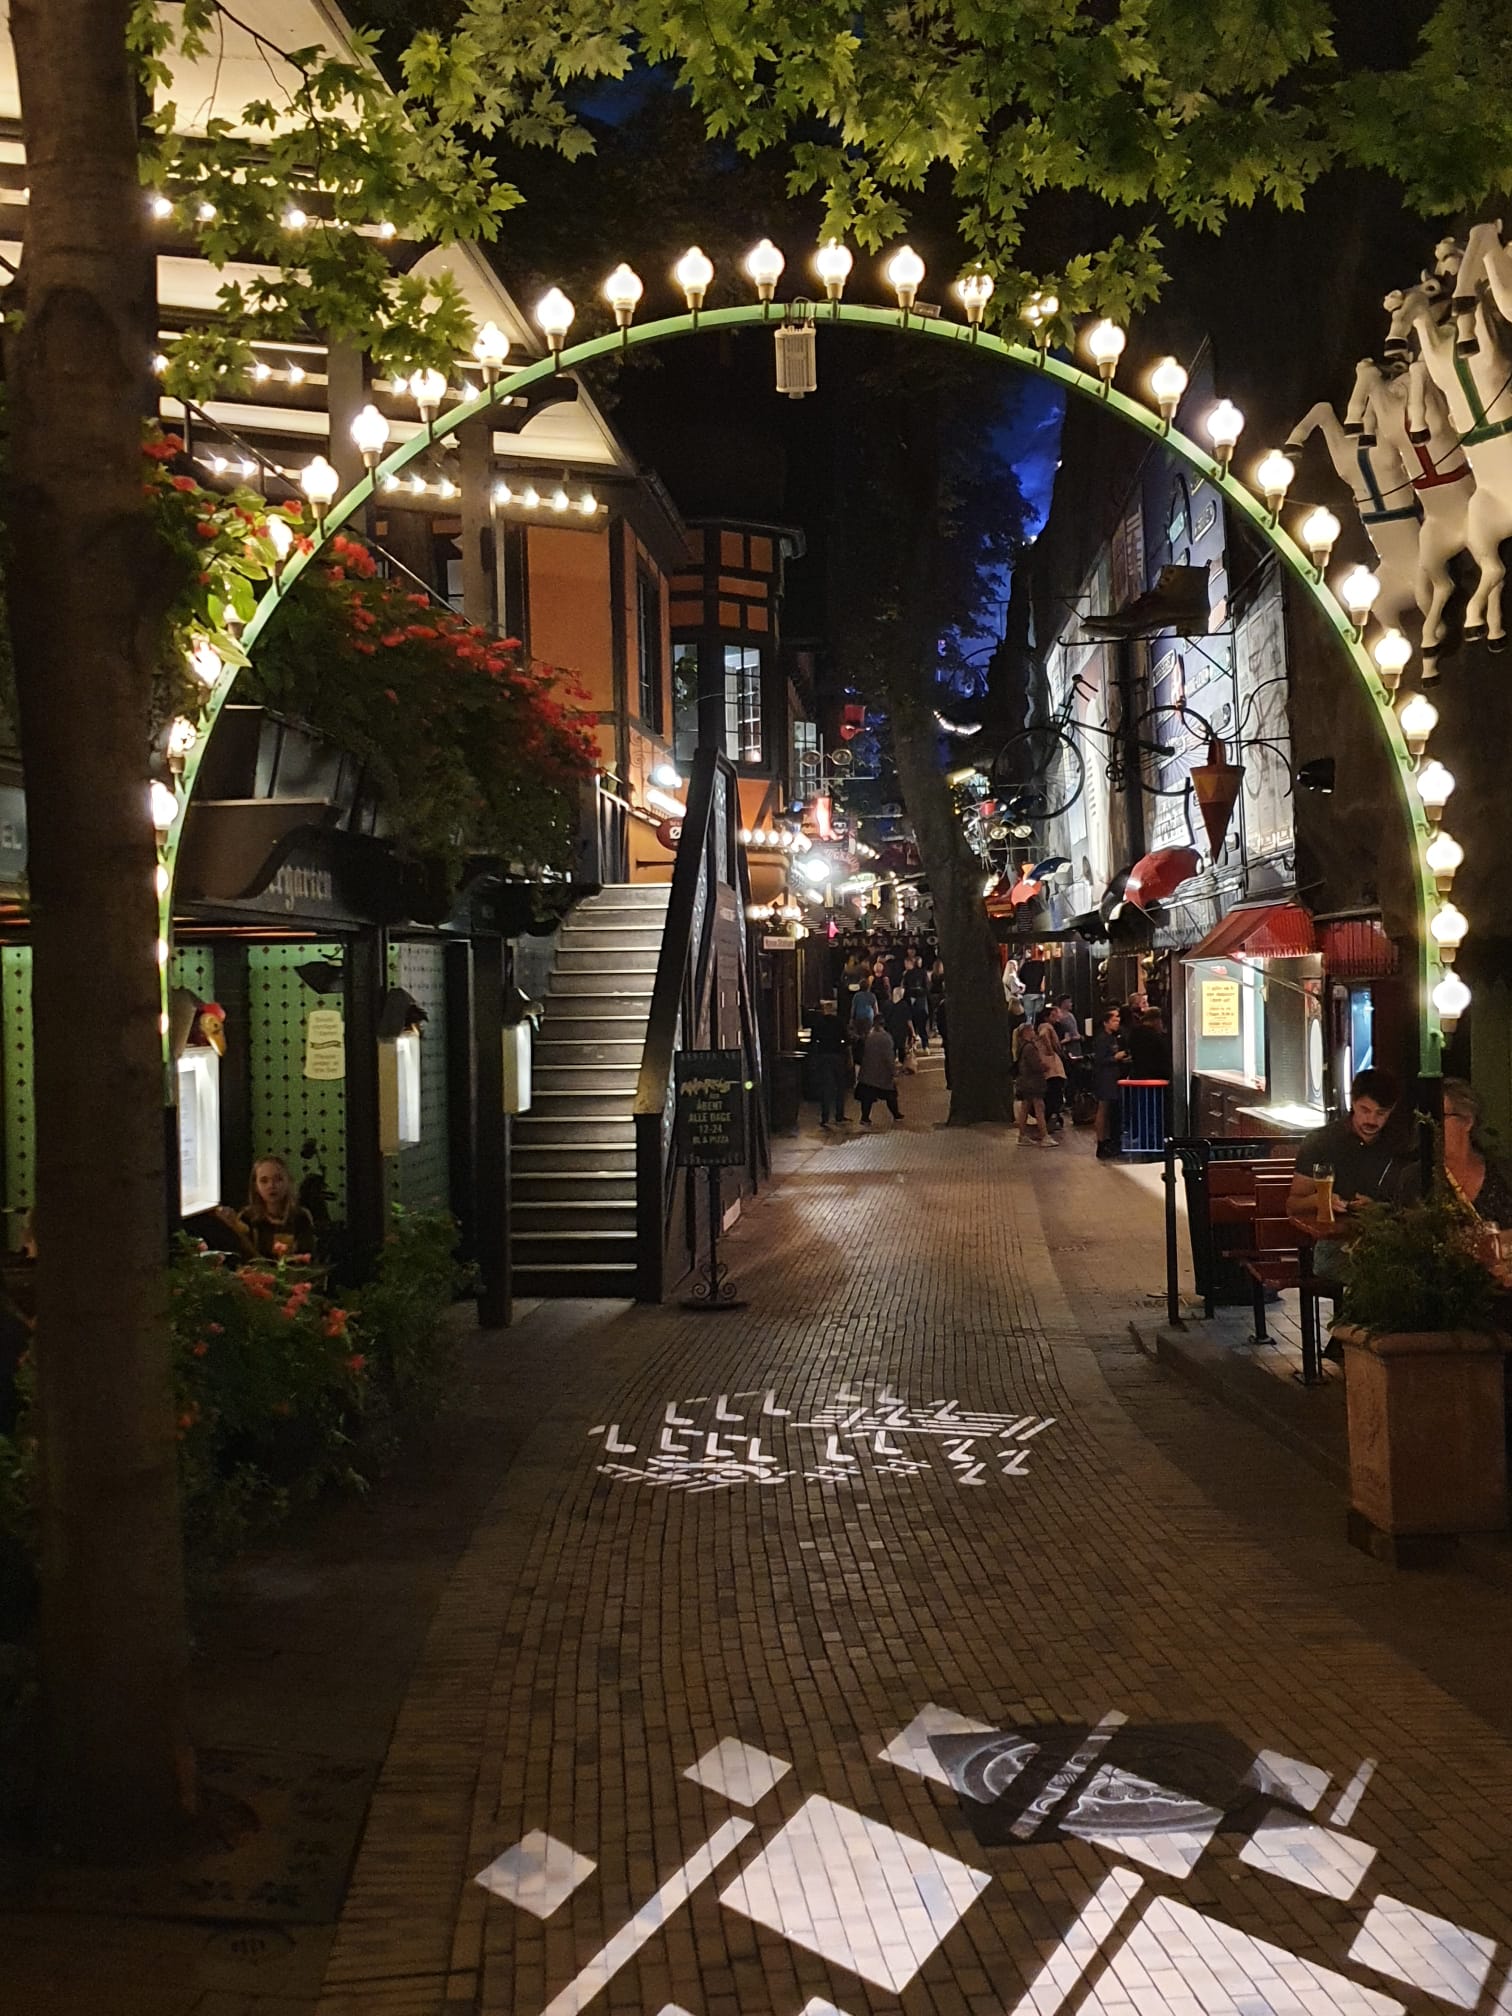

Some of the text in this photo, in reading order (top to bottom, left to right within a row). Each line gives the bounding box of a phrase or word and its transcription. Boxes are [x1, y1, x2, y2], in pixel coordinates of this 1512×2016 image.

[696, 1098, 722, 1111] ÅBENT
[688, 1112, 731, 1122] ALLE DAGE
[699, 1124, 722, 1134] 12-24
